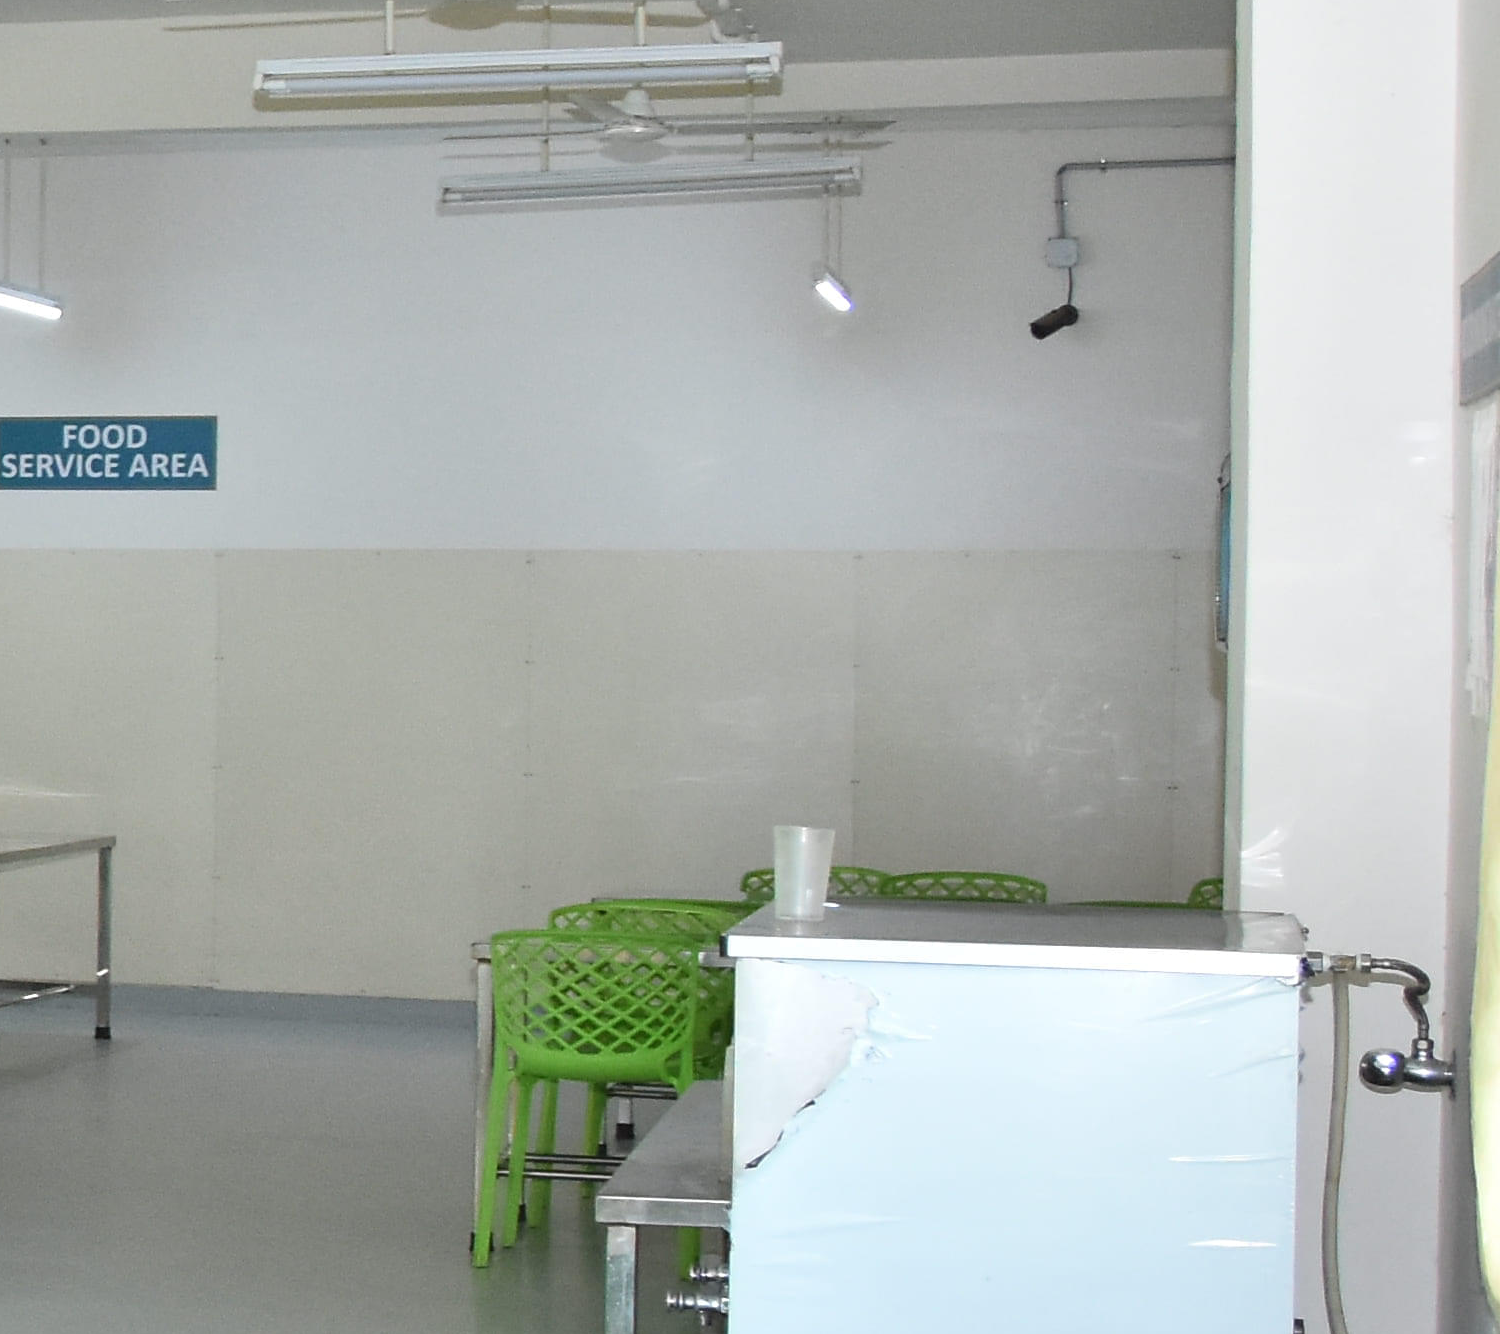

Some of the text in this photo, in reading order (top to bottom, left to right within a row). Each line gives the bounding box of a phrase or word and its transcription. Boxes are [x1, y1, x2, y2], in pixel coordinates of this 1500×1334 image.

[62, 424, 148, 449] FOOD
[1, 453, 209, 478] SERVICE AREA
